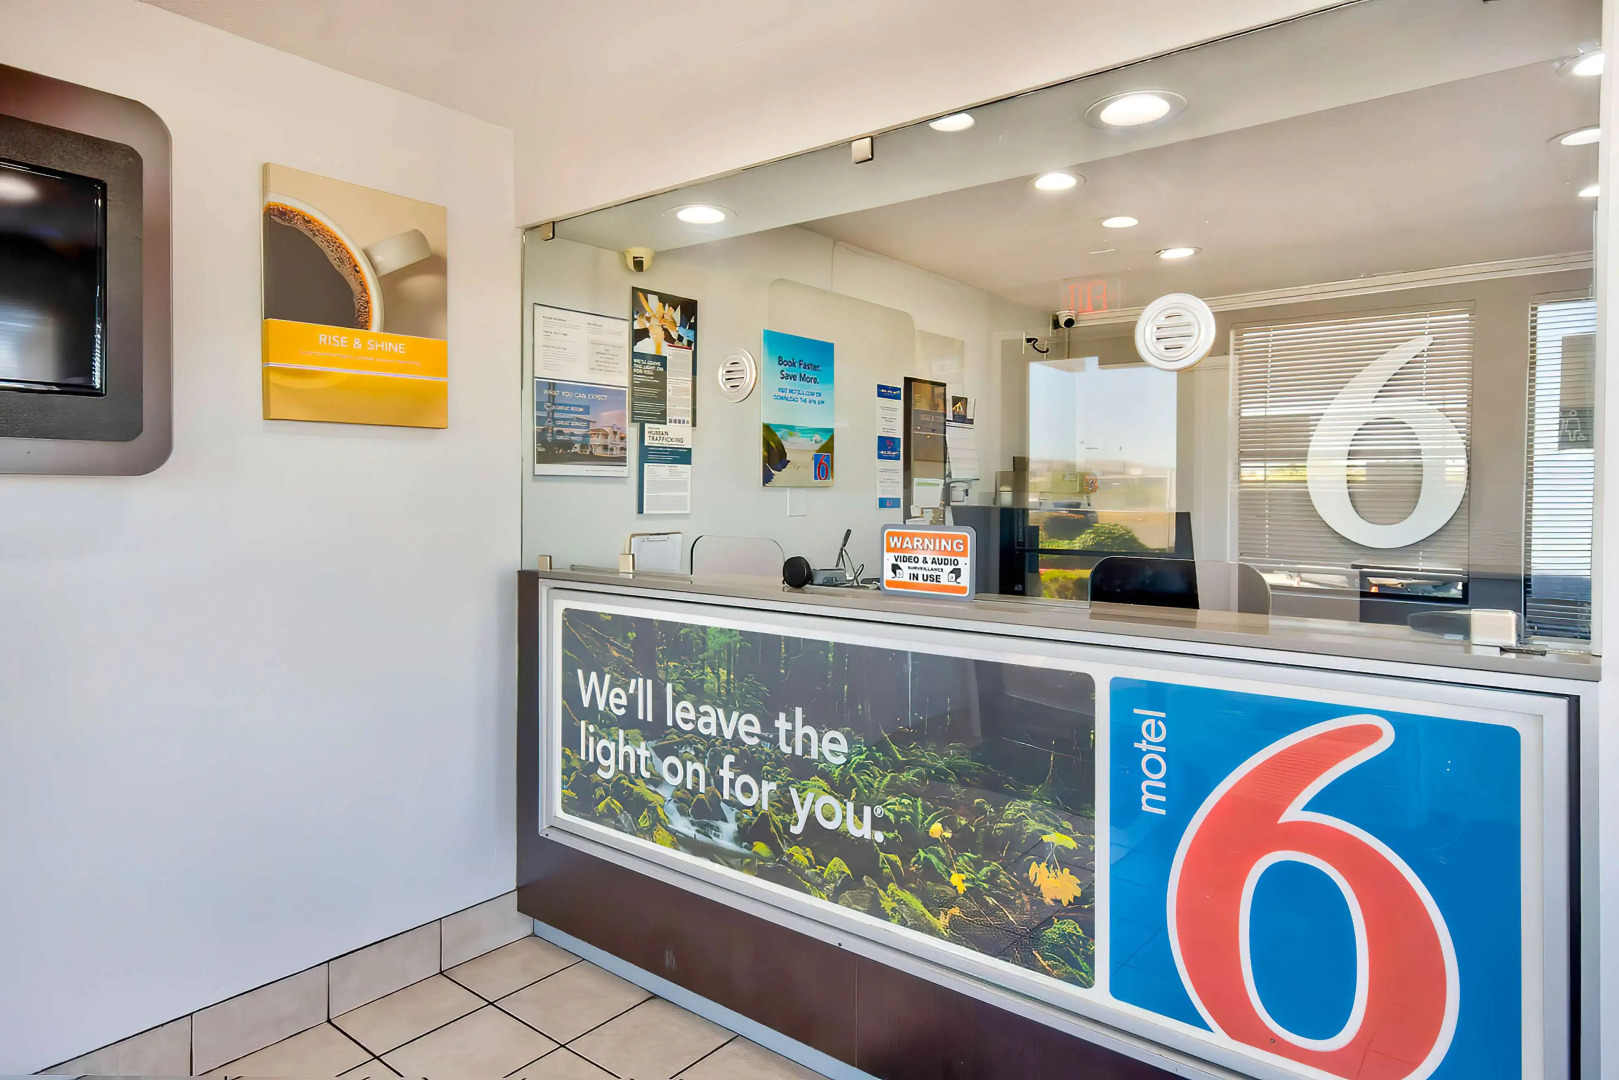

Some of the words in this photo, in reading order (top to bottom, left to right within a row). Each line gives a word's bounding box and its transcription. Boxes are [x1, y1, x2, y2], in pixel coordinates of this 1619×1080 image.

[319, 334, 348, 347] RISE
[353, 338, 362, 349] &
[367, 339, 406, 354] SHINE
[777, 355, 797, 368] Book
[798, 359, 822, 371] Faster.
[780, 369, 797, 381] Save
[799, 372, 820, 384] More.
[648, 435, 684, 444] TRAFFICKING
[1306, 335, 1468, 549] 6
[816, 454, 829, 481] 6
[889, 535, 965, 552] WARNING
[893, 554, 920, 564] VIDEO
[922, 556, 929, 565] &
[931, 557, 959, 567] AUDIO
[907, 565, 944, 573] SURVEILLANCE
[908, 572, 919, 581] IN
[921, 573, 942, 583] USE
[576, 668, 653, 722] We'll
[666, 682, 762, 745] leave
[774, 706, 849, 765] the
[580, 719, 651, 780] light
[662, 755, 706, 794] on
[718, 754, 777, 811] for
[1133, 708, 1167, 815] motel
[1166, 713, 1460, 1080] 6
